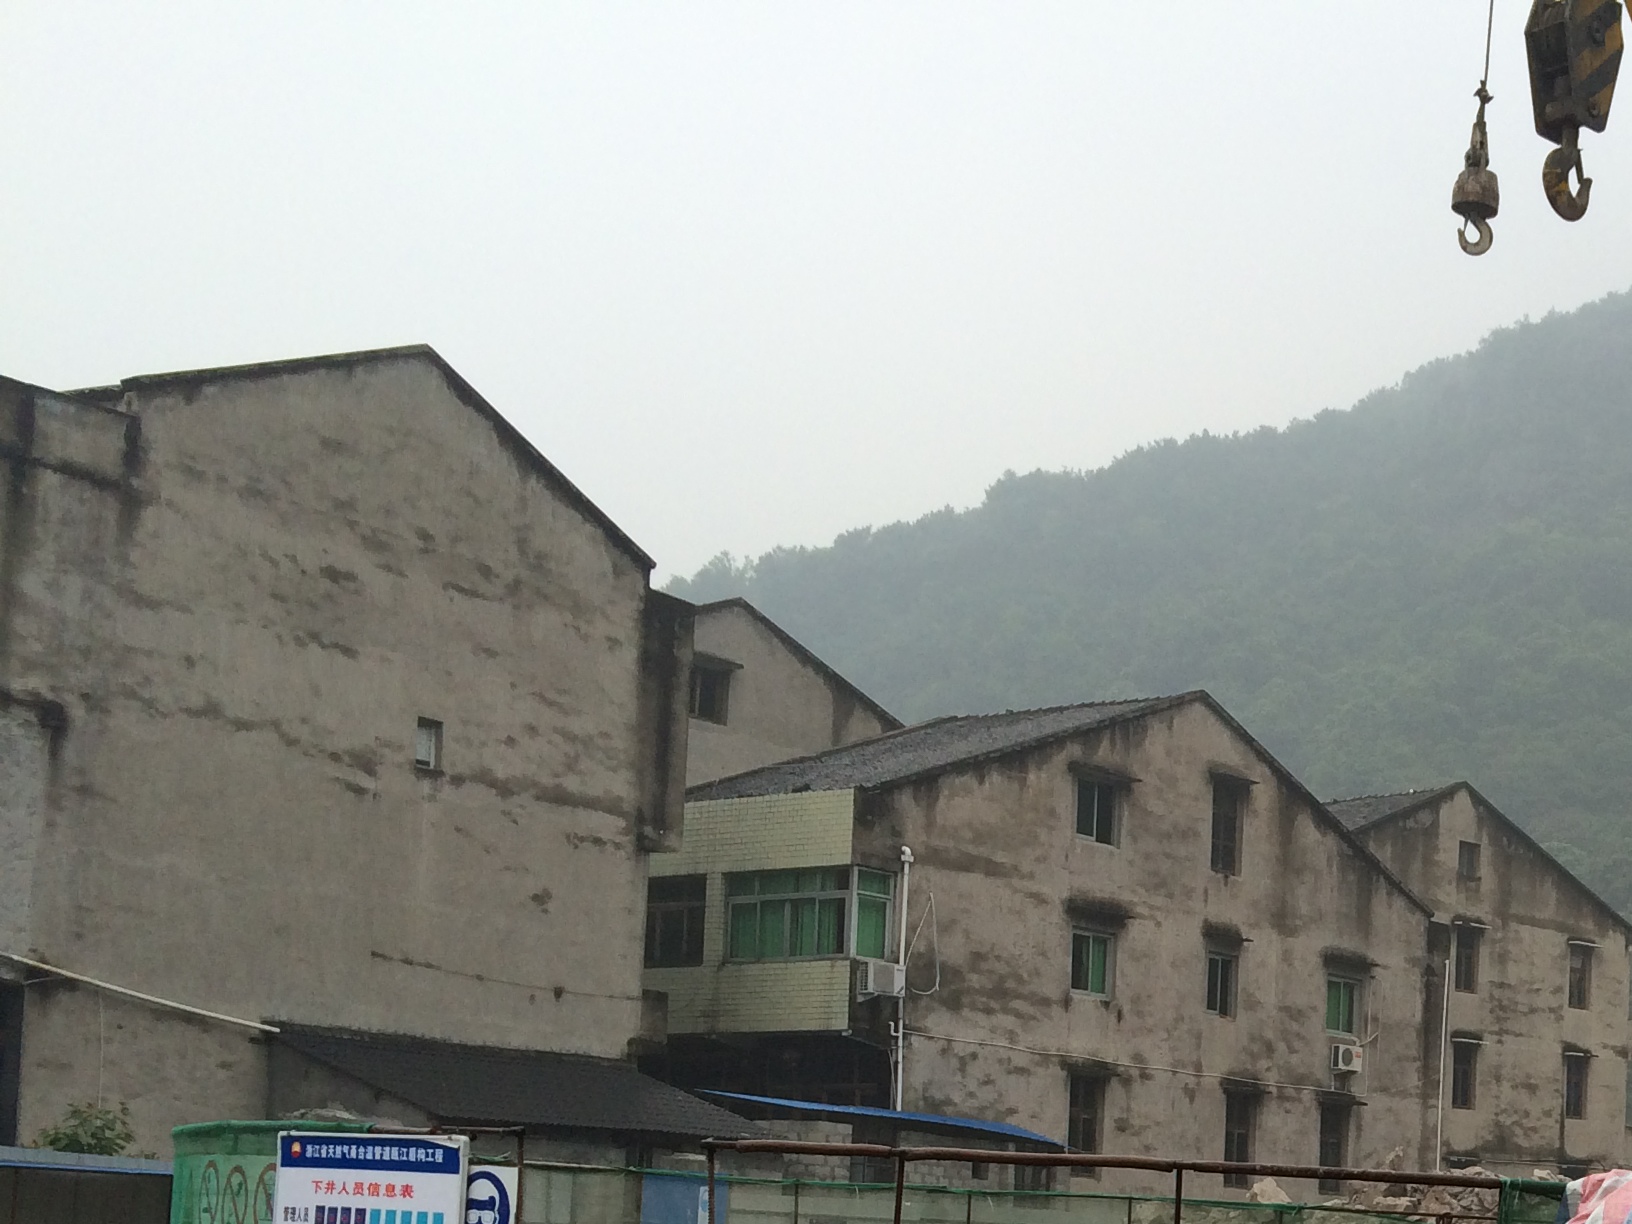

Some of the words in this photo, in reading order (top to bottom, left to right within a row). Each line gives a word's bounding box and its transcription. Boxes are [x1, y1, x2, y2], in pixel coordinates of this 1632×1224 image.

[312, 1180, 414, 1198] 下井人员信息表
[283, 1206, 309, 1222] 管理人员
